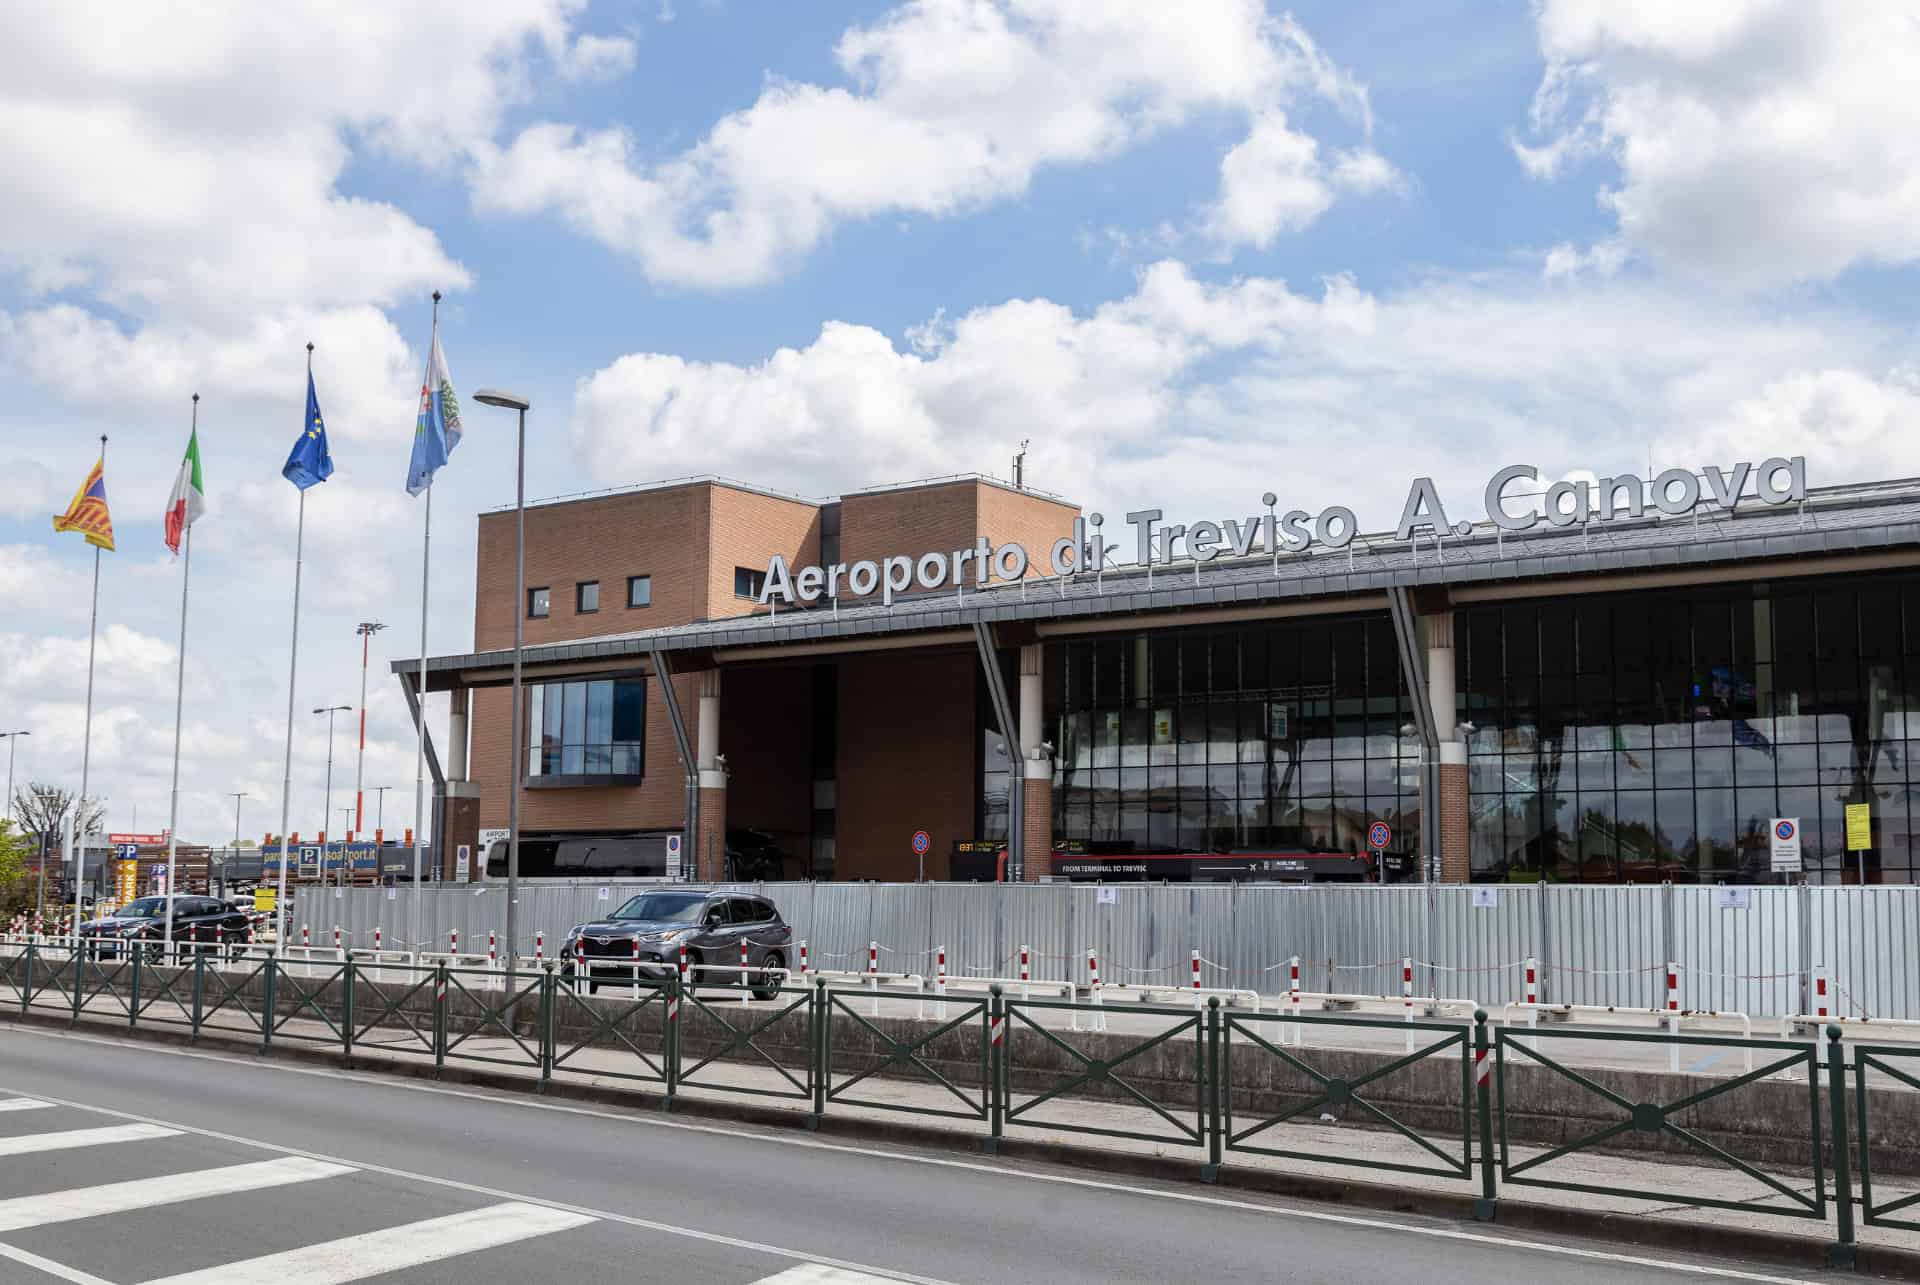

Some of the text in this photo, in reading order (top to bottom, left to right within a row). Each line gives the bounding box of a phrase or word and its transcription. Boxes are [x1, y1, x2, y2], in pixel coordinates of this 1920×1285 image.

[758, 536, 1029, 606] Aeroporto
[1051, 512, 1104, 577] di
[1126, 492, 1358, 567] Treviso
[126, 845, 137, 858] P
[304, 848, 314, 862] P
[1062, 864, 1080, 873] FROM
[1081, 864, 1112, 873] TERMINAL
[1113, 864, 1121, 873] TO
